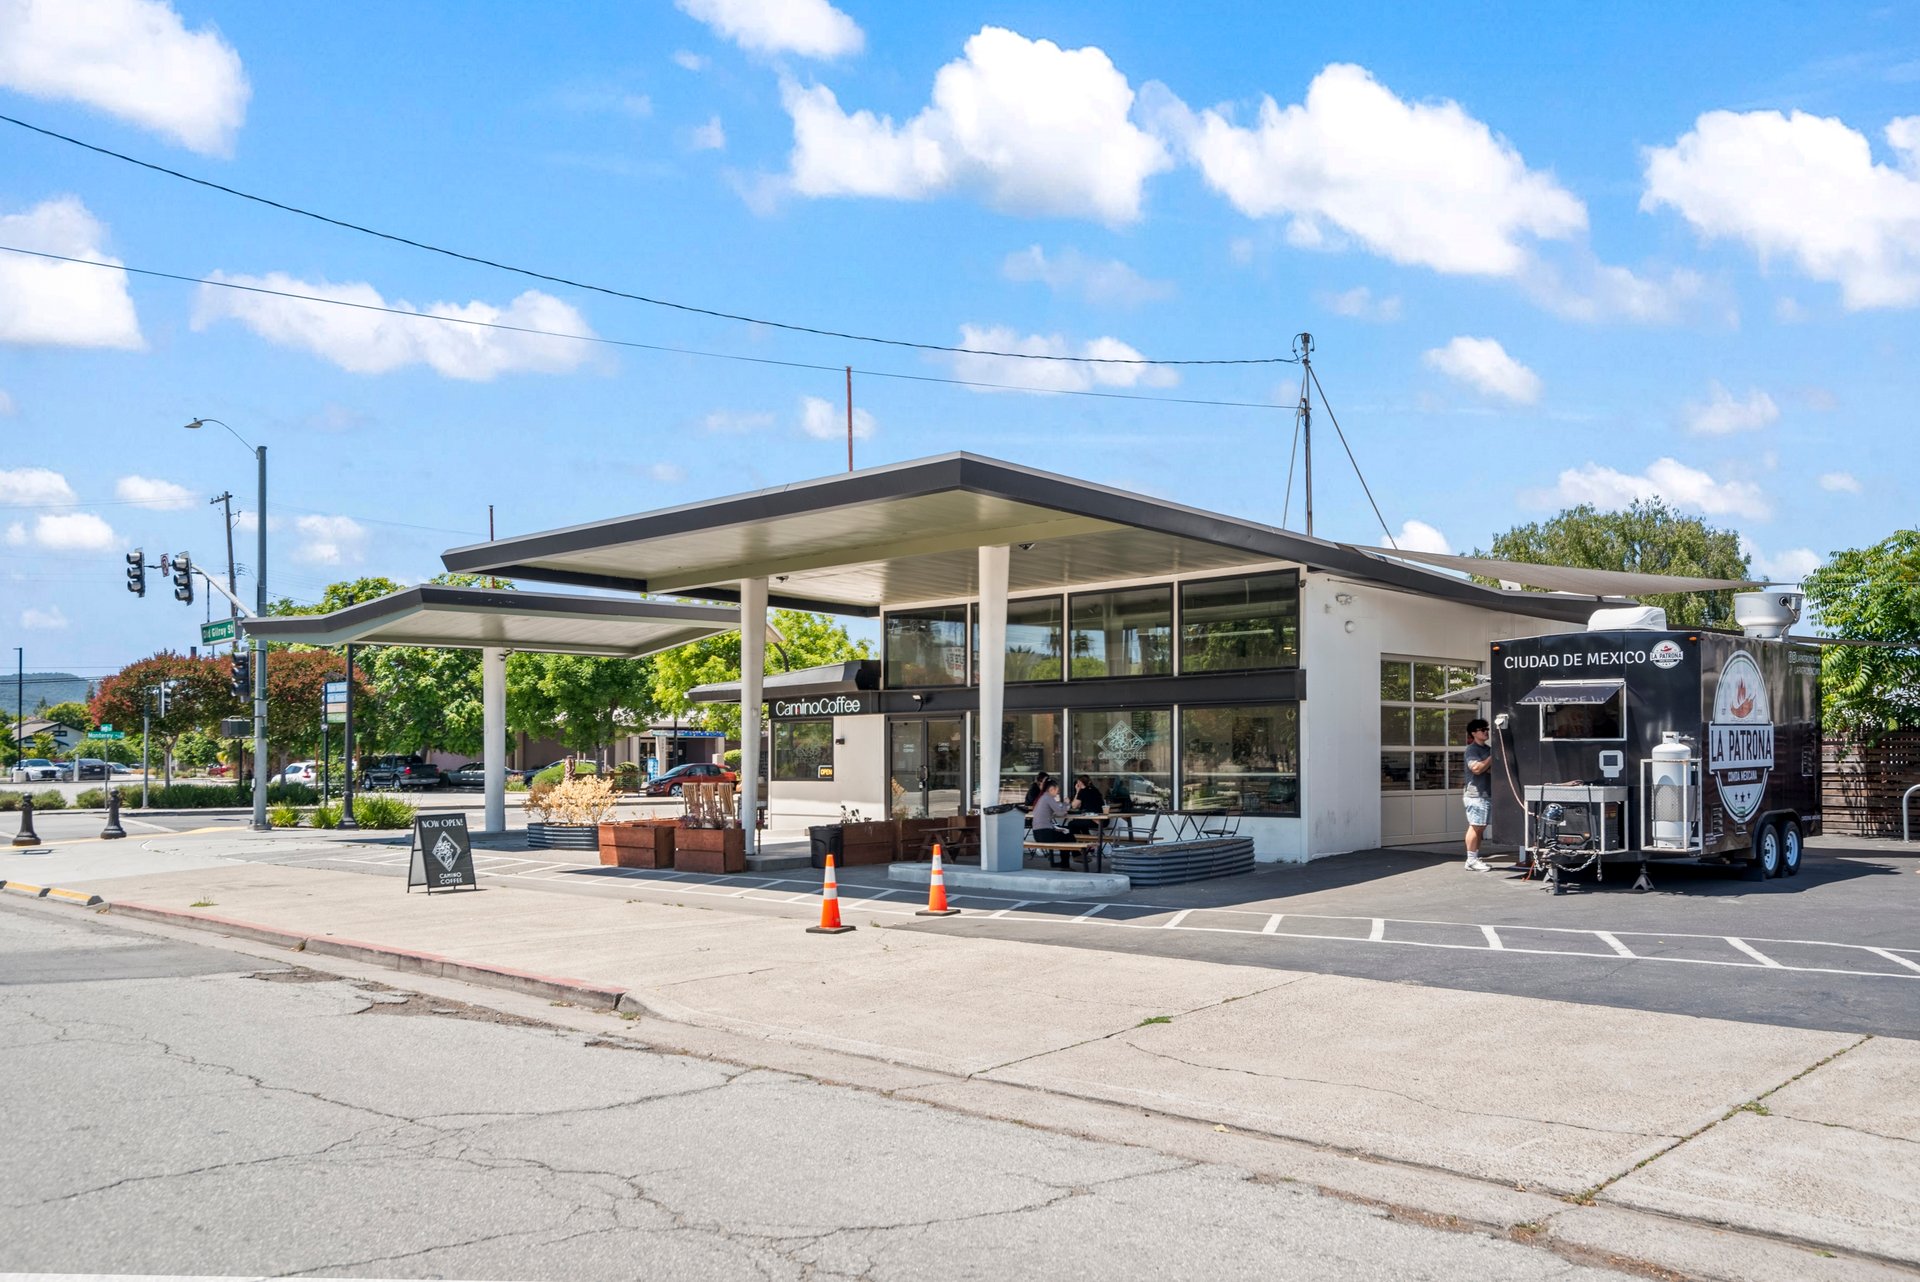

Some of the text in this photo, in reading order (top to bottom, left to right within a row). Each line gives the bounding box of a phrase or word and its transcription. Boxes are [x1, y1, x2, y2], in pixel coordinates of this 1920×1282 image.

[1504, 650, 1646, 669] CIUDAD DE MEXICO
[1660, 652, 1682, 660] PATRONA
[1711, 729, 1772, 762] LA PATRONA
[1122, 751, 1146, 760] COFFEE
[820, 768, 832, 776] OPEN
[421, 818, 463, 828] NOW OPEN!
